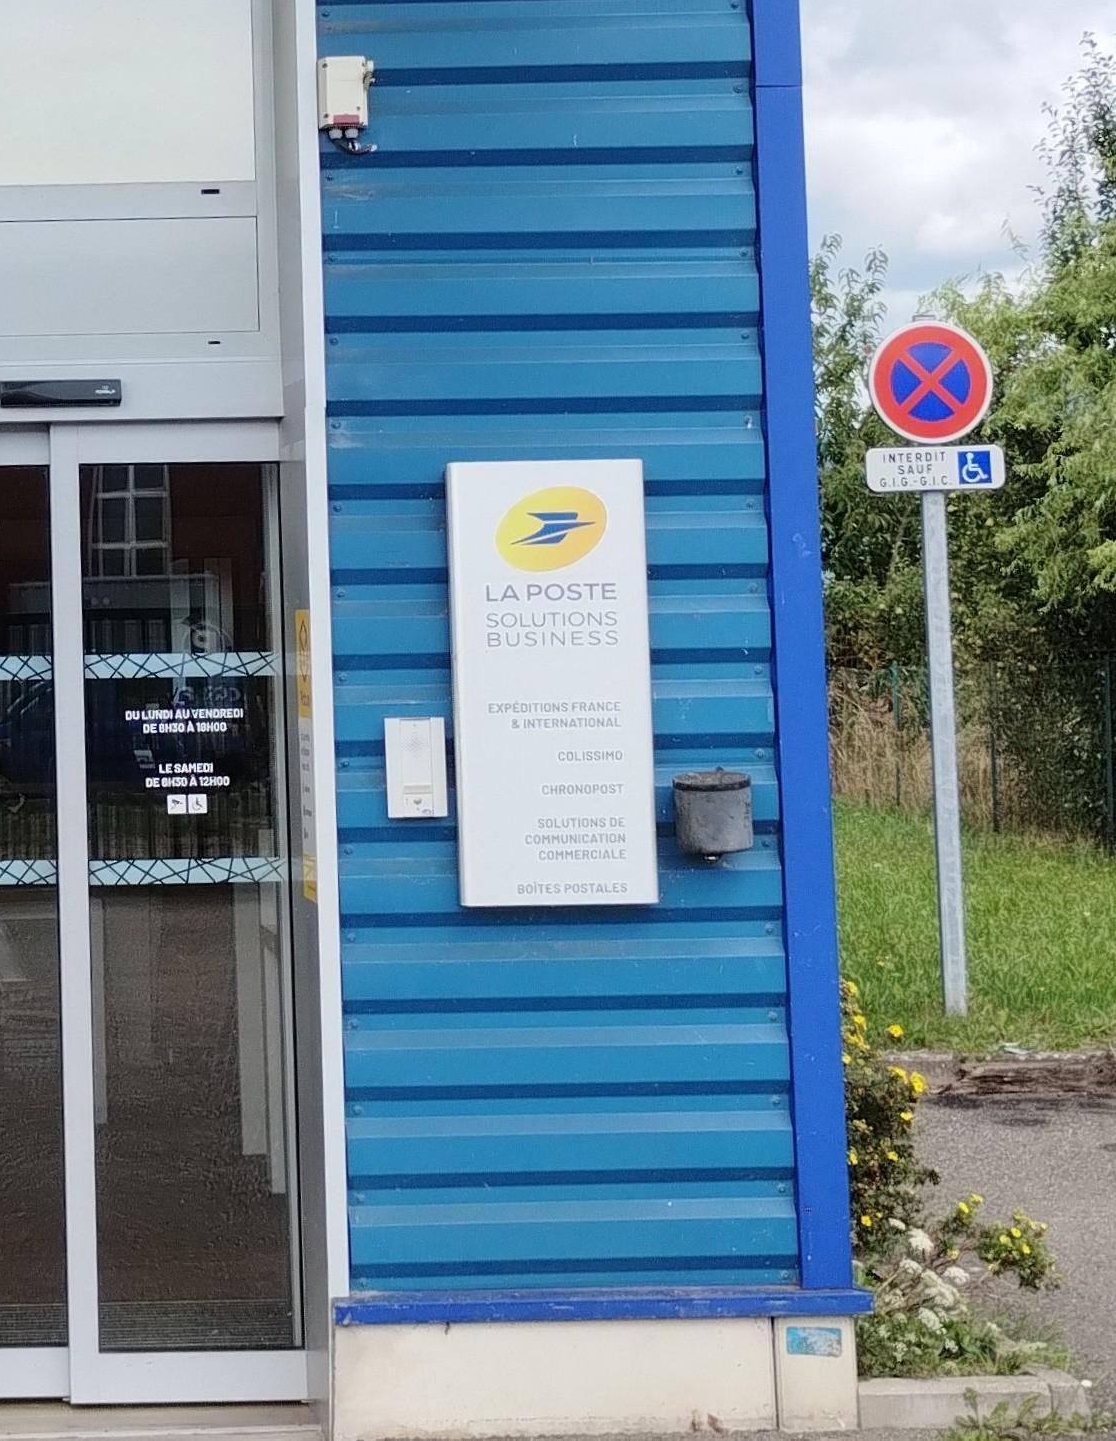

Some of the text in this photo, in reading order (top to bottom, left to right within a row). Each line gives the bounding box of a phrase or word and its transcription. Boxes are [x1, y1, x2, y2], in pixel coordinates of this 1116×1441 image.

[882, 451, 946, 463] INTERDIT
[897, 464, 933, 475] SAUF
[485, 583, 617, 602] LA POSTE
[485, 611, 618, 628] SOLUTIONS
[487, 630, 619, 647] BUSINESS
[487, 700, 621, 713] EXPÉDITIONS FRANCE
[125, 708, 244, 721] DU LUNDI AU VENDREDI
[143, 723, 157, 734] DE
[511, 717, 622, 729] & INTERNATIONAL
[557, 750, 623, 762] COLISSIMO
[159, 762, 214, 774] LE SAMEDI
[145, 777, 160, 788] DE
[199, 776, 230, 786] 12H00
[541, 783, 624, 795] CHRONOPOST
[537, 817, 625, 829] SOLUTIONS DE
[524, 833, 627, 845] COMMUNICATION
[538, 849, 627, 861] COMMERCIALE
[517, 881, 628, 894] BOÎTES POSTALES
